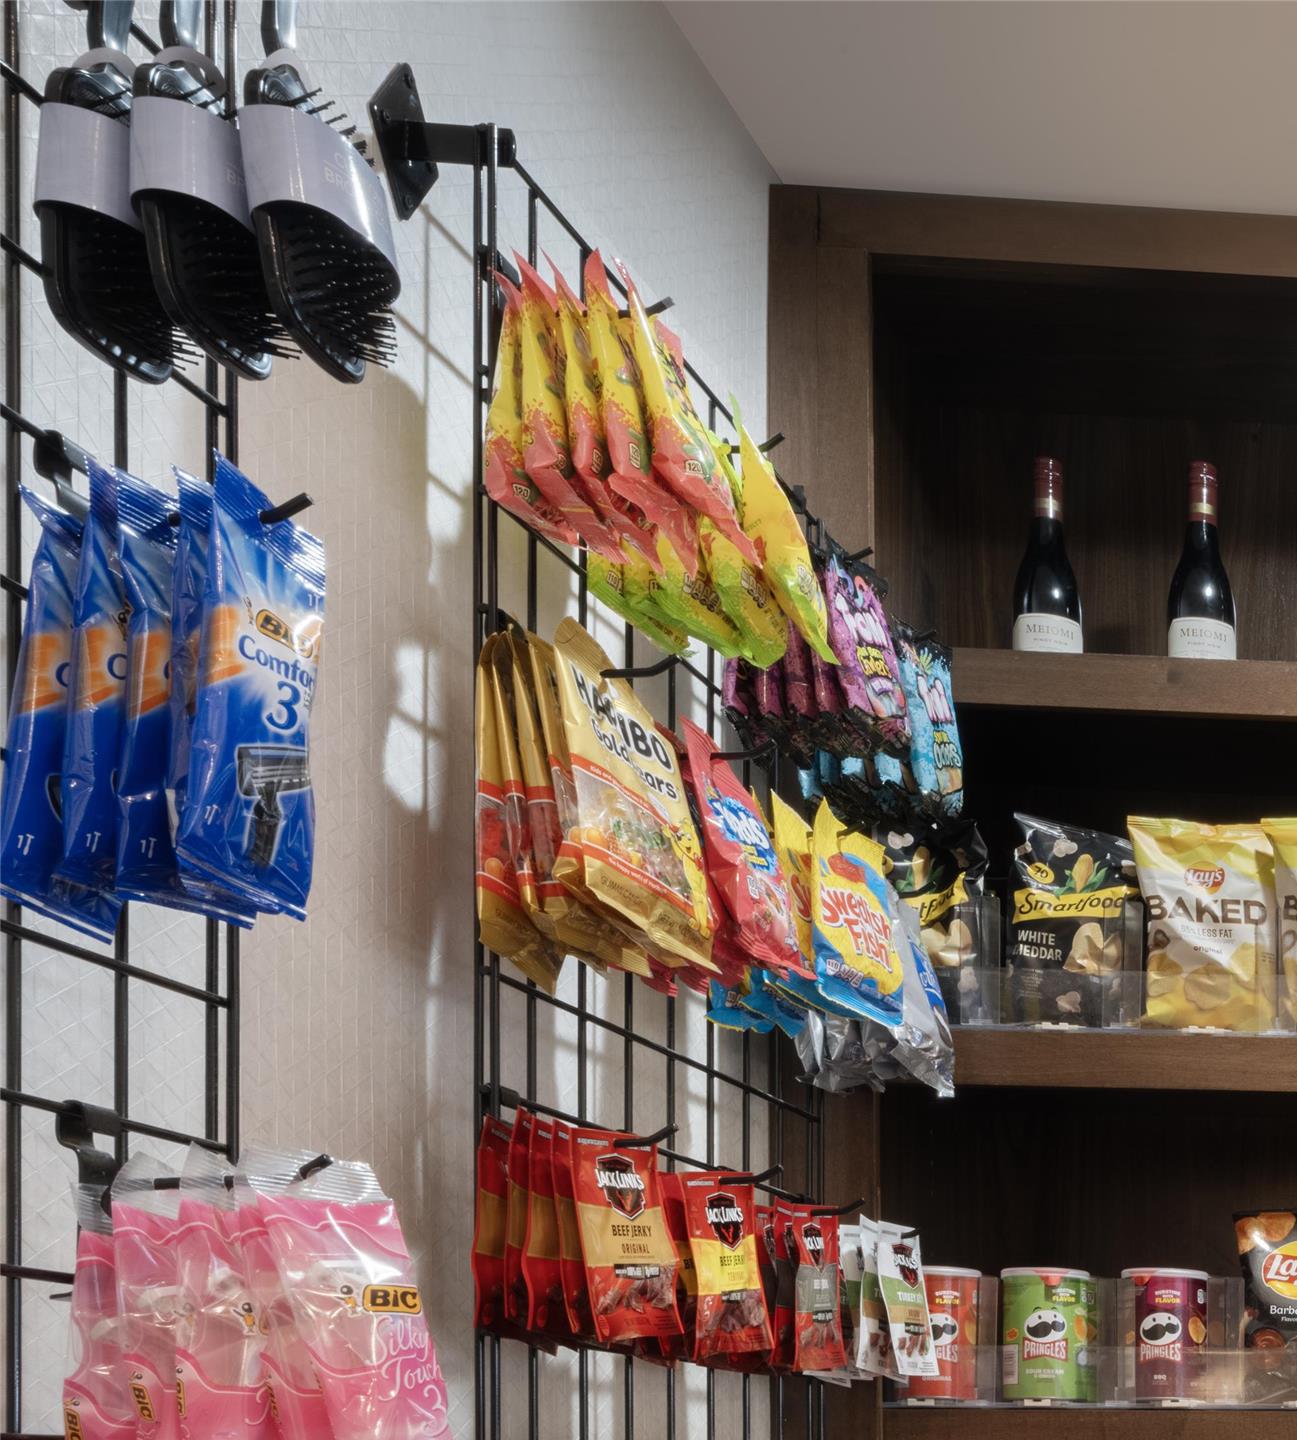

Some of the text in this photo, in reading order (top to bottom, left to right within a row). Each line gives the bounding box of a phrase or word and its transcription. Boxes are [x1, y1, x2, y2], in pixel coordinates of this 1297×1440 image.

[1026, 624, 1075, 640] MEIOMI
[1179, 627, 1227, 642] MEIOMI
[265, 680, 301, 730] 3
[1186, 868, 1224, 889] Lay's
[1147, 895, 1267, 925] BAKED
[1018, 930, 1056, 945] WHITE
[1198, 926, 1233, 938] LESS FAT
[845, 919, 893, 973] Fish
[1193, 945, 1223, 954] original
[612, 1224, 652, 1238] BEEF JERKY
[621, 1243, 651, 1254] ORIGINAL
[374, 1315, 430, 1363] Silky
[1024, 1340, 1067, 1360] PRINGLES
[1140, 1342, 1181, 1362] PRINGLES
[379, 1362, 445, 1401] Touch
